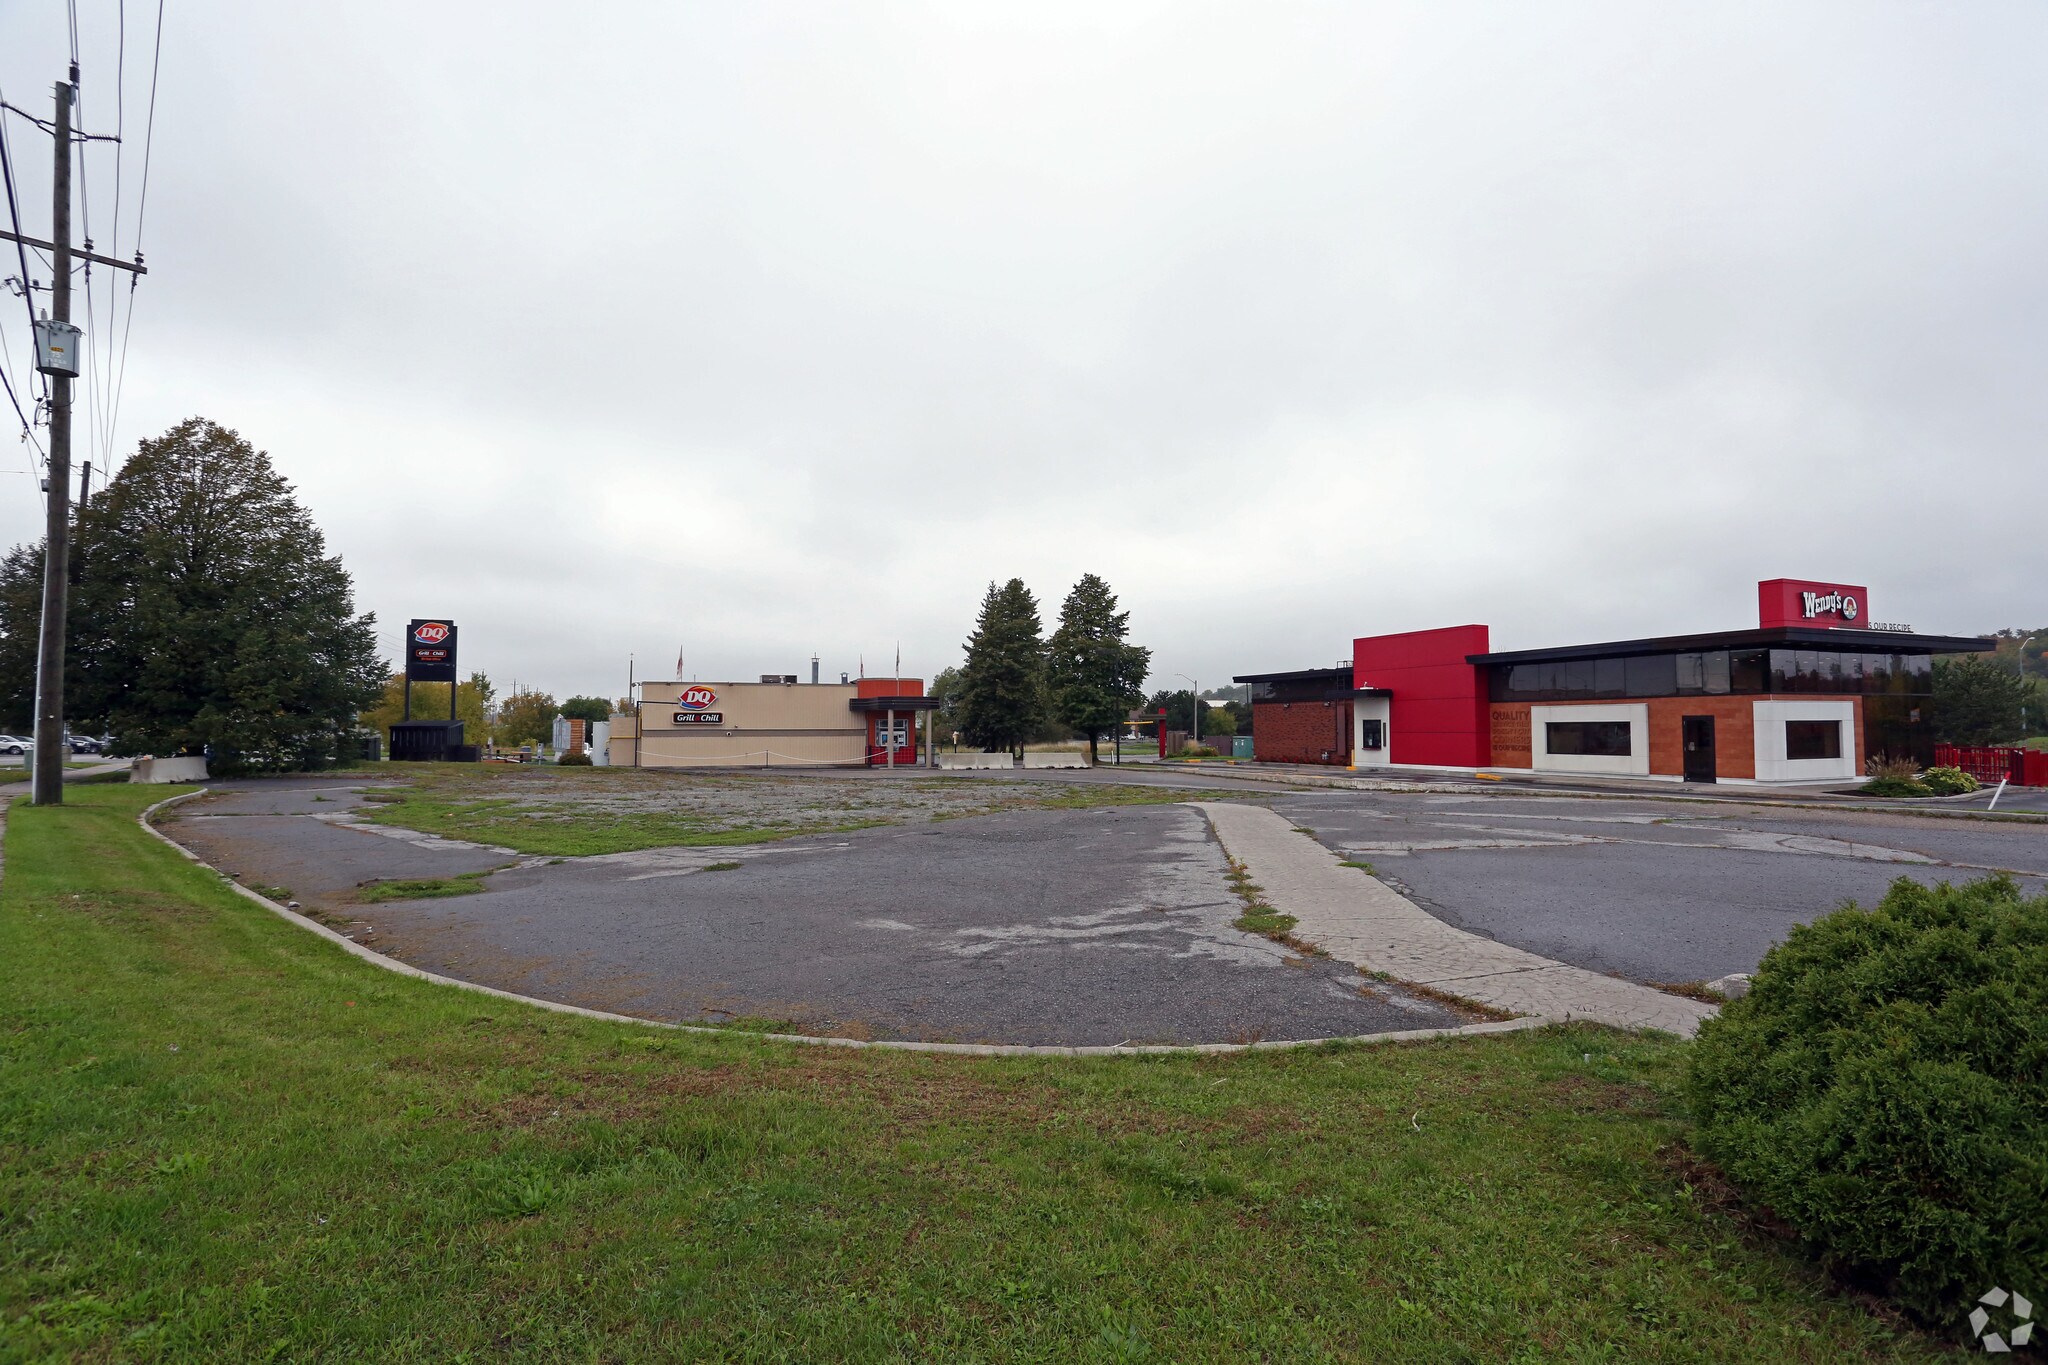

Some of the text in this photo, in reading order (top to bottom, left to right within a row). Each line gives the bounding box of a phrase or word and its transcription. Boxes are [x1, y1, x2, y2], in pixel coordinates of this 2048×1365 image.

[1873, 622, 1888, 631] OUR
[1888, 623, 1911, 632] RECIPE
[421, 627, 444, 639] DQ
[686, 690, 711, 704] DQ
[677, 714, 695, 722] Grill
[700, 714, 719, 722] Chill
[1492, 711, 1530, 720] QUALITY
